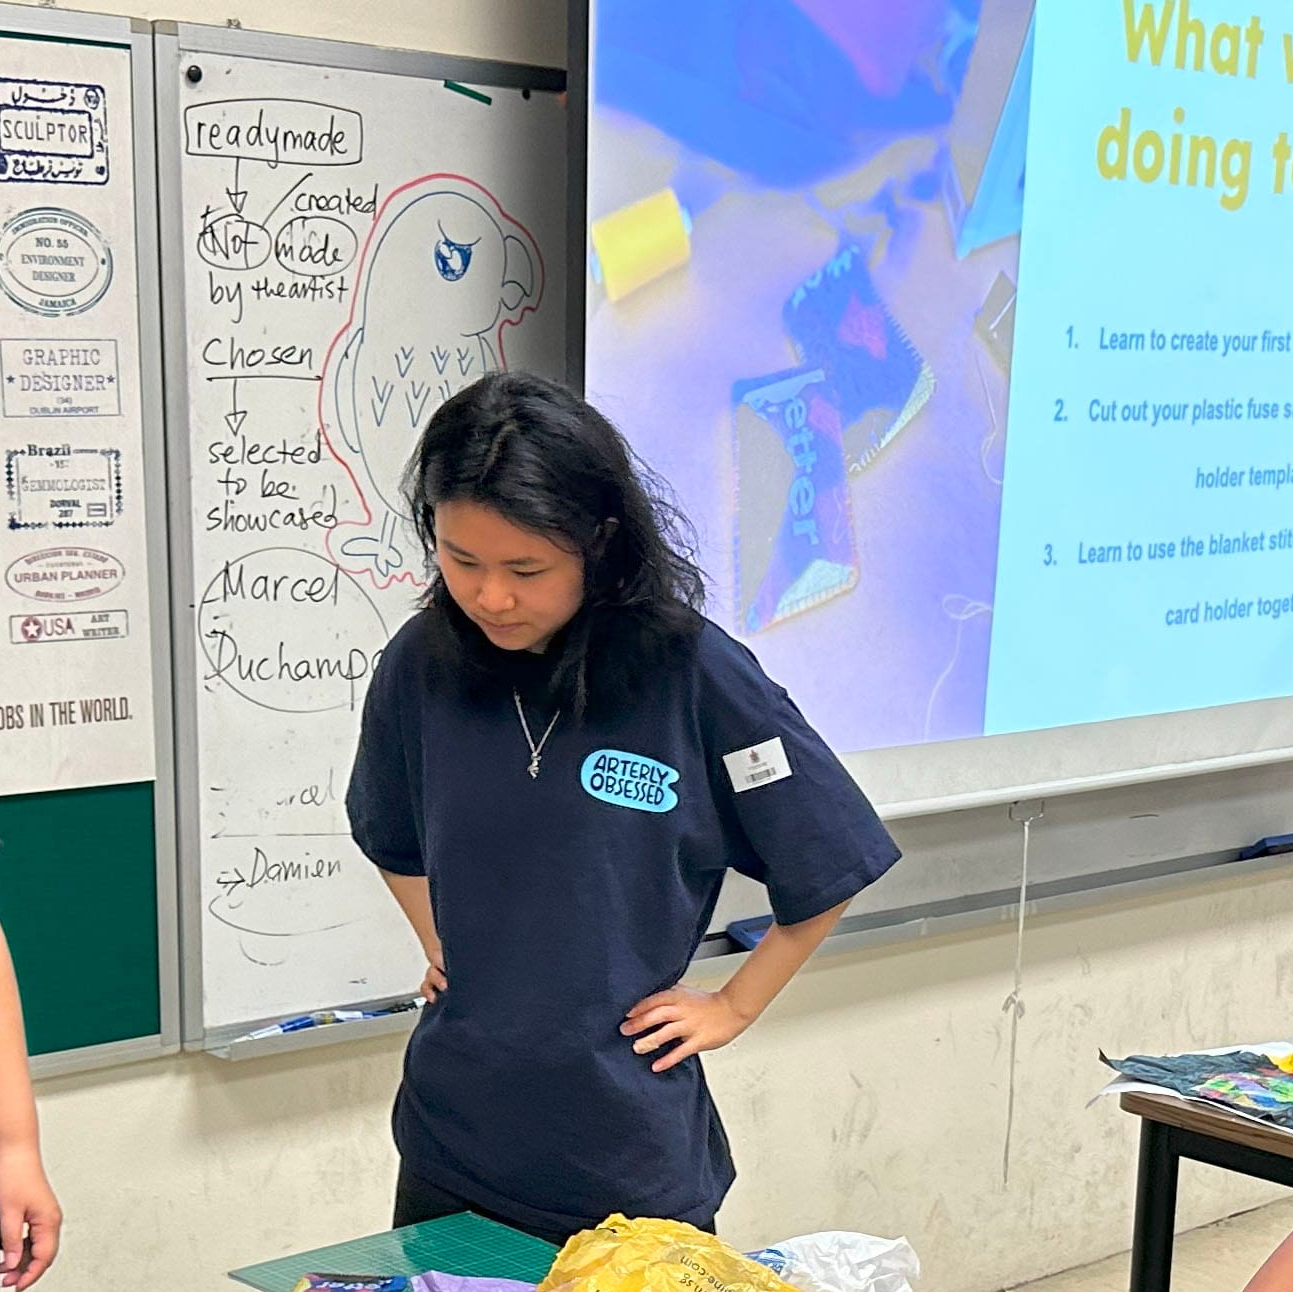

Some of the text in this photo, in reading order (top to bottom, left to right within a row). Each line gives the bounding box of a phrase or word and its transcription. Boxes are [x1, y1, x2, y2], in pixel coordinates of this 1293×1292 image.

[1121, 0, 1264, 80] What
[2, 119, 88, 144] SCULPTOR
[195, 108, 348, 168] readymade
[1096, 106, 1253, 211] doing
[290, 183, 379, 214] created
[276, 216, 344, 266] made
[20, 253, 84, 267] ENVIRONMENT
[32, 270, 76, 282] DESIGNER
[209, 272, 243, 324] by
[22, 348, 101, 366] GRAPHIC
[202, 337, 314, 370] Chosen
[1066, 325, 1079, 350] 1.
[1099, 327, 1144, 351] Learn
[1150, 329, 1167, 351] to
[1171, 330, 1219, 352] create
[1222, 333, 1259, 357] your
[1260, 330, 1291, 353] first
[19, 374, 107, 392] DESIGNER
[1053, 398, 1069, 423] 2.
[1088, 398, 1118, 423] Cut
[1121, 400, 1149, 423] out
[1151, 401, 1190, 427] your
[1192, 398, 1244, 426] plastic
[1246, 398, 1280, 420] fuse
[208, 429, 321, 465] selected
[217, 468, 247, 496] to
[1195, 466, 1245, 489] holder
[206, 489, 339, 533] showcased
[1042, 542, 1058, 567] 3.
[1078, 541, 1122, 564] Learn
[1126, 540, 1143, 562] to
[1147, 540, 1176, 560] use
[1180, 535, 1205, 558] the
[1208, 530, 1266, 556] blanket
[14, 569, 118, 584] URBAN PLANNER
[220, 560, 341, 606] Marcel
[44, 617, 76, 637] USA
[1165, 602, 1199, 626] card
[1203, 598, 1253, 623] holder
[29, 703, 44, 728] IN
[49, 701, 76, 726] THE
[79, 696, 133, 724] WORLD.
[593, 754, 669, 787] ARTERLY
[590, 772, 665, 806] OBSESSED
[249, 849, 341, 890] Damien
